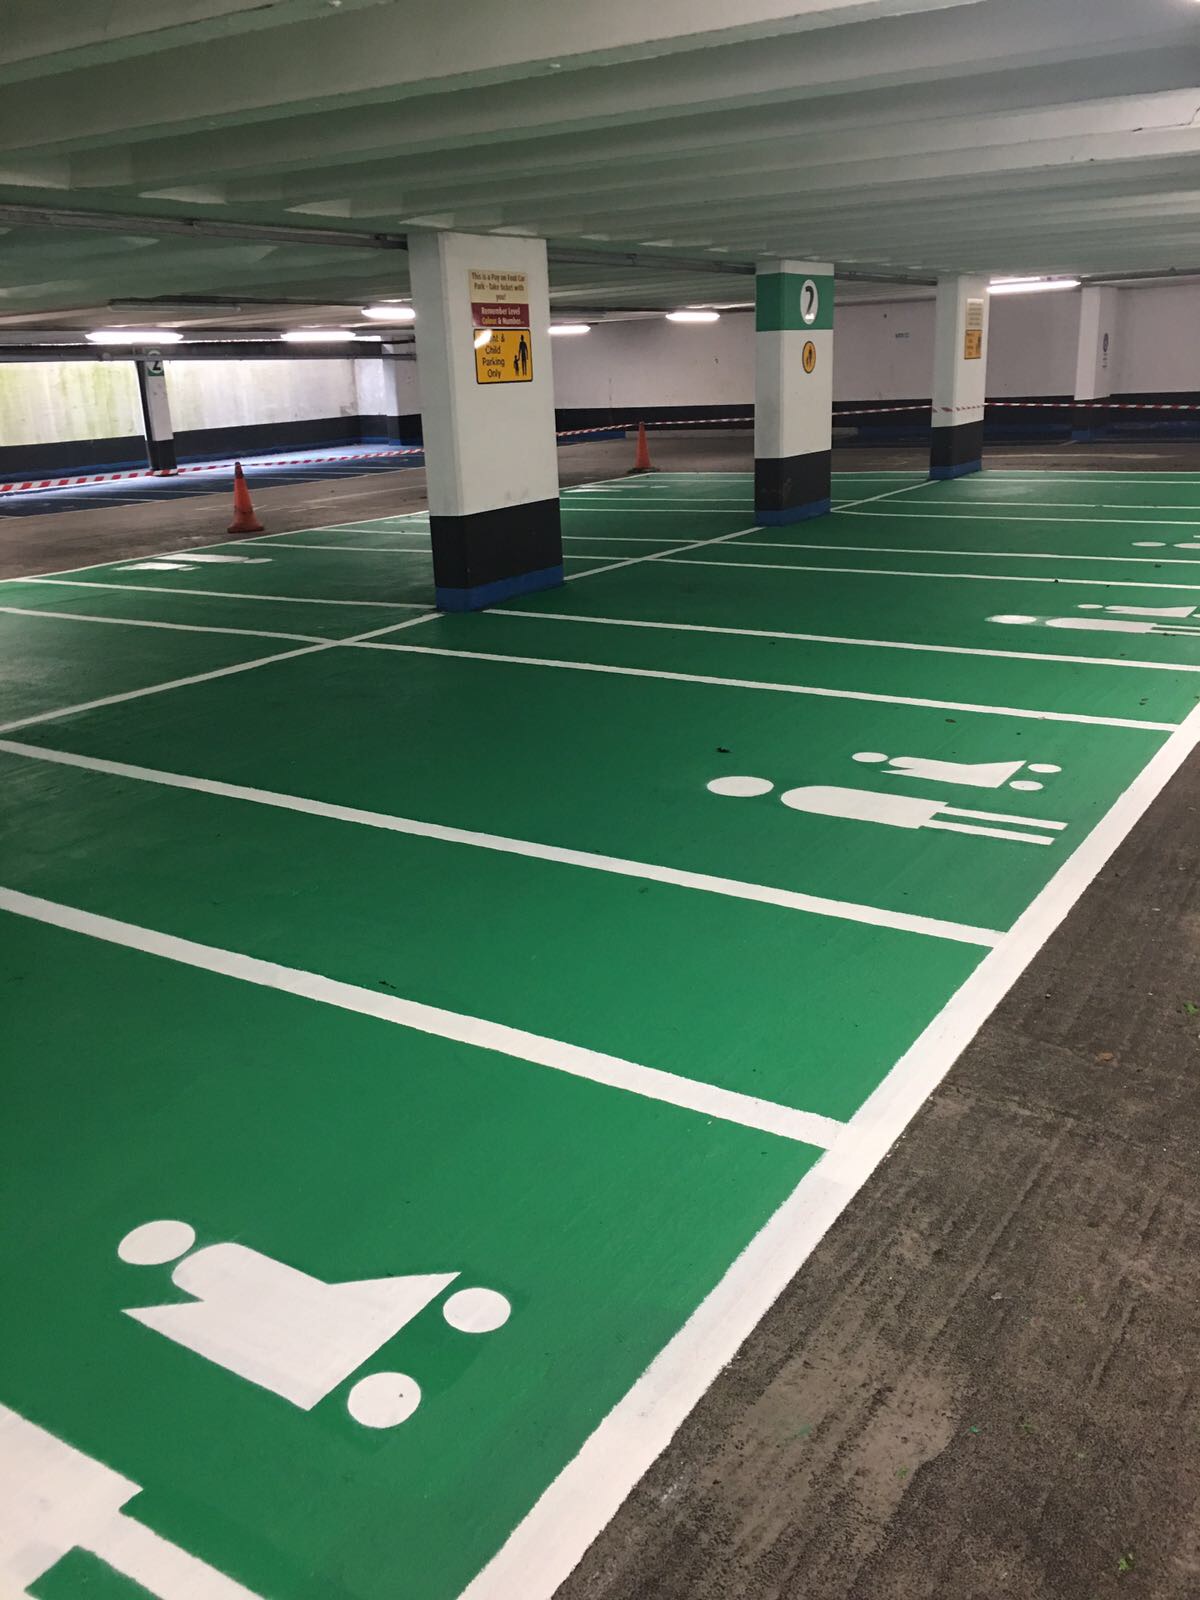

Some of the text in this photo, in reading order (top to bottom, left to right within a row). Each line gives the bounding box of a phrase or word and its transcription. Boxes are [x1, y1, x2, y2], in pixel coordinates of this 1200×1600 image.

[472, 272, 481, 280] This
[491, 273, 500, 282] Pay
[474, 282, 485, 290] Park
[481, 307, 520, 315] Remember Level
[485, 345, 501, 354] Child
[482, 357, 505, 367] Parking
[487, 369, 501, 379] Only
